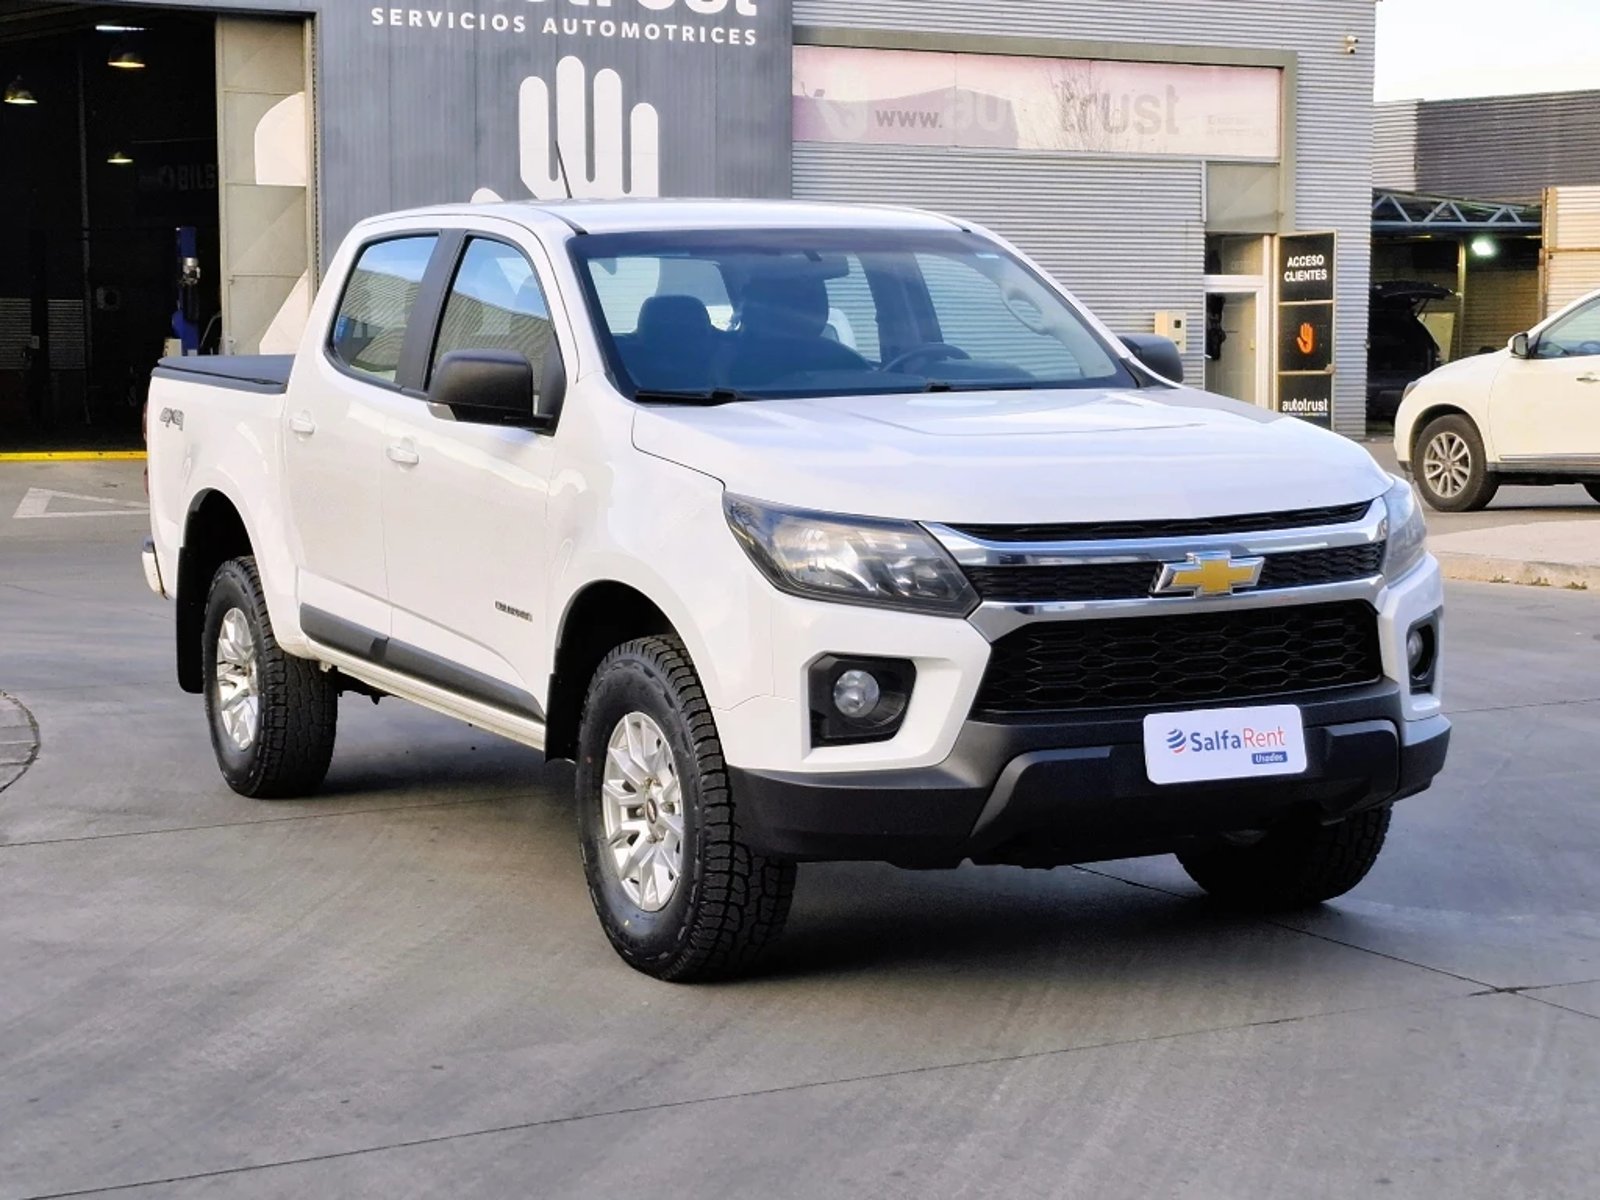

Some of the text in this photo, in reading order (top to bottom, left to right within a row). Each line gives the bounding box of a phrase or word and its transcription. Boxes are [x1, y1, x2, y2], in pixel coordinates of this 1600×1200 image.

[371, 8, 526, 33] SERVICIOS
[541, 18, 757, 46] AUTOMOTRICES
[1287, 254, 1324, 268] ACCESO
[1284, 269, 1327, 282] CLIENTES
[1282, 398, 1328, 411] autotrust
[1190, 726, 1285, 752] SalfaRent
[1255, 753, 1284, 764] Usados
